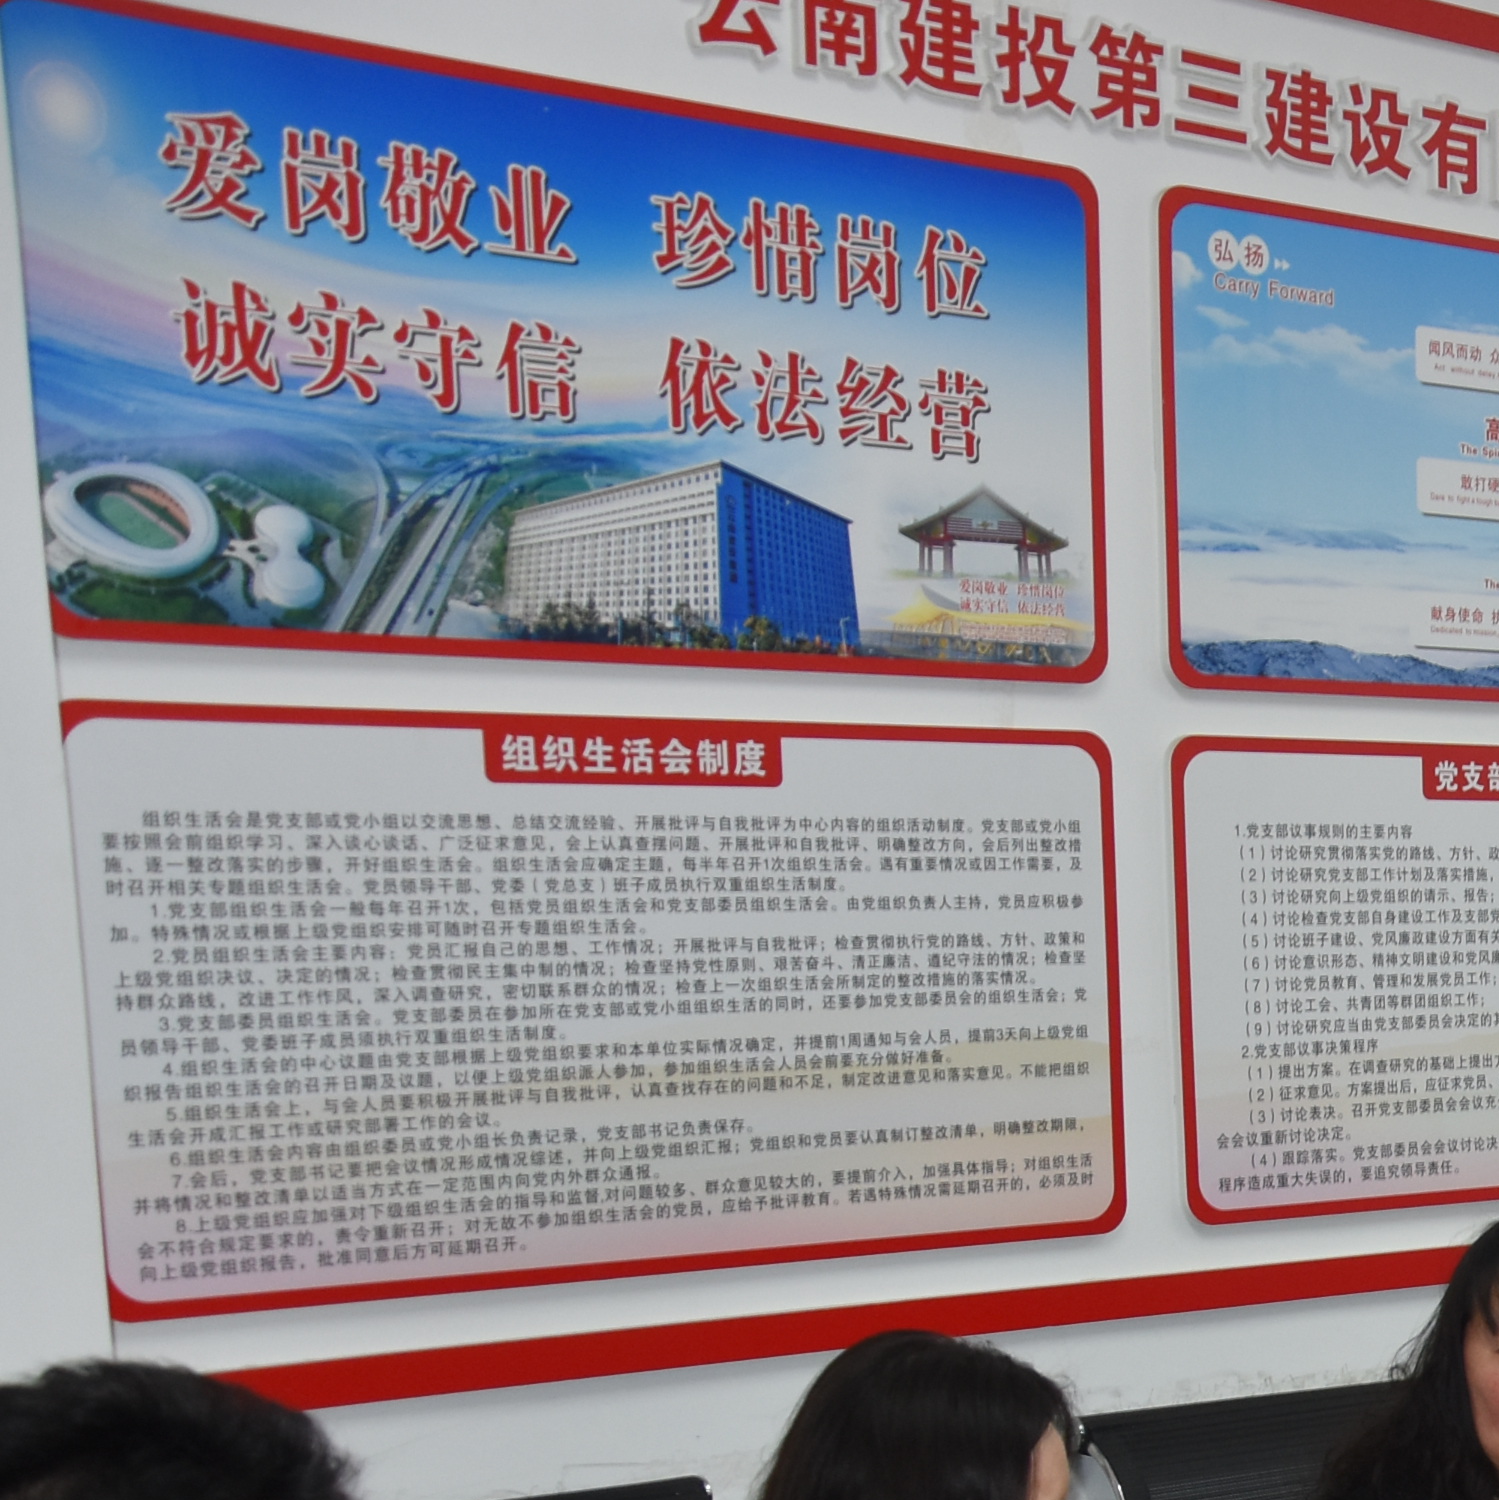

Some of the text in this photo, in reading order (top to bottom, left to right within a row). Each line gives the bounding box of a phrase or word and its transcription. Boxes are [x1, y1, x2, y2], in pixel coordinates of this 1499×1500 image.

[160, 110, 990, 321] 爱岗敬业 珍惜岗位
[1214, 238, 1264, 268] 弘扬
[1214, 272, 1335, 307] Carry Forward
[1428, 339, 1482, 362] 闻风而动
[173, 277, 990, 463] 诚实守信 依法经营
[1460, 443, 1477, 456] The
[1430, 605, 1484, 624] 献身使命
[502, 733, 767, 777] 组织生活会制度
